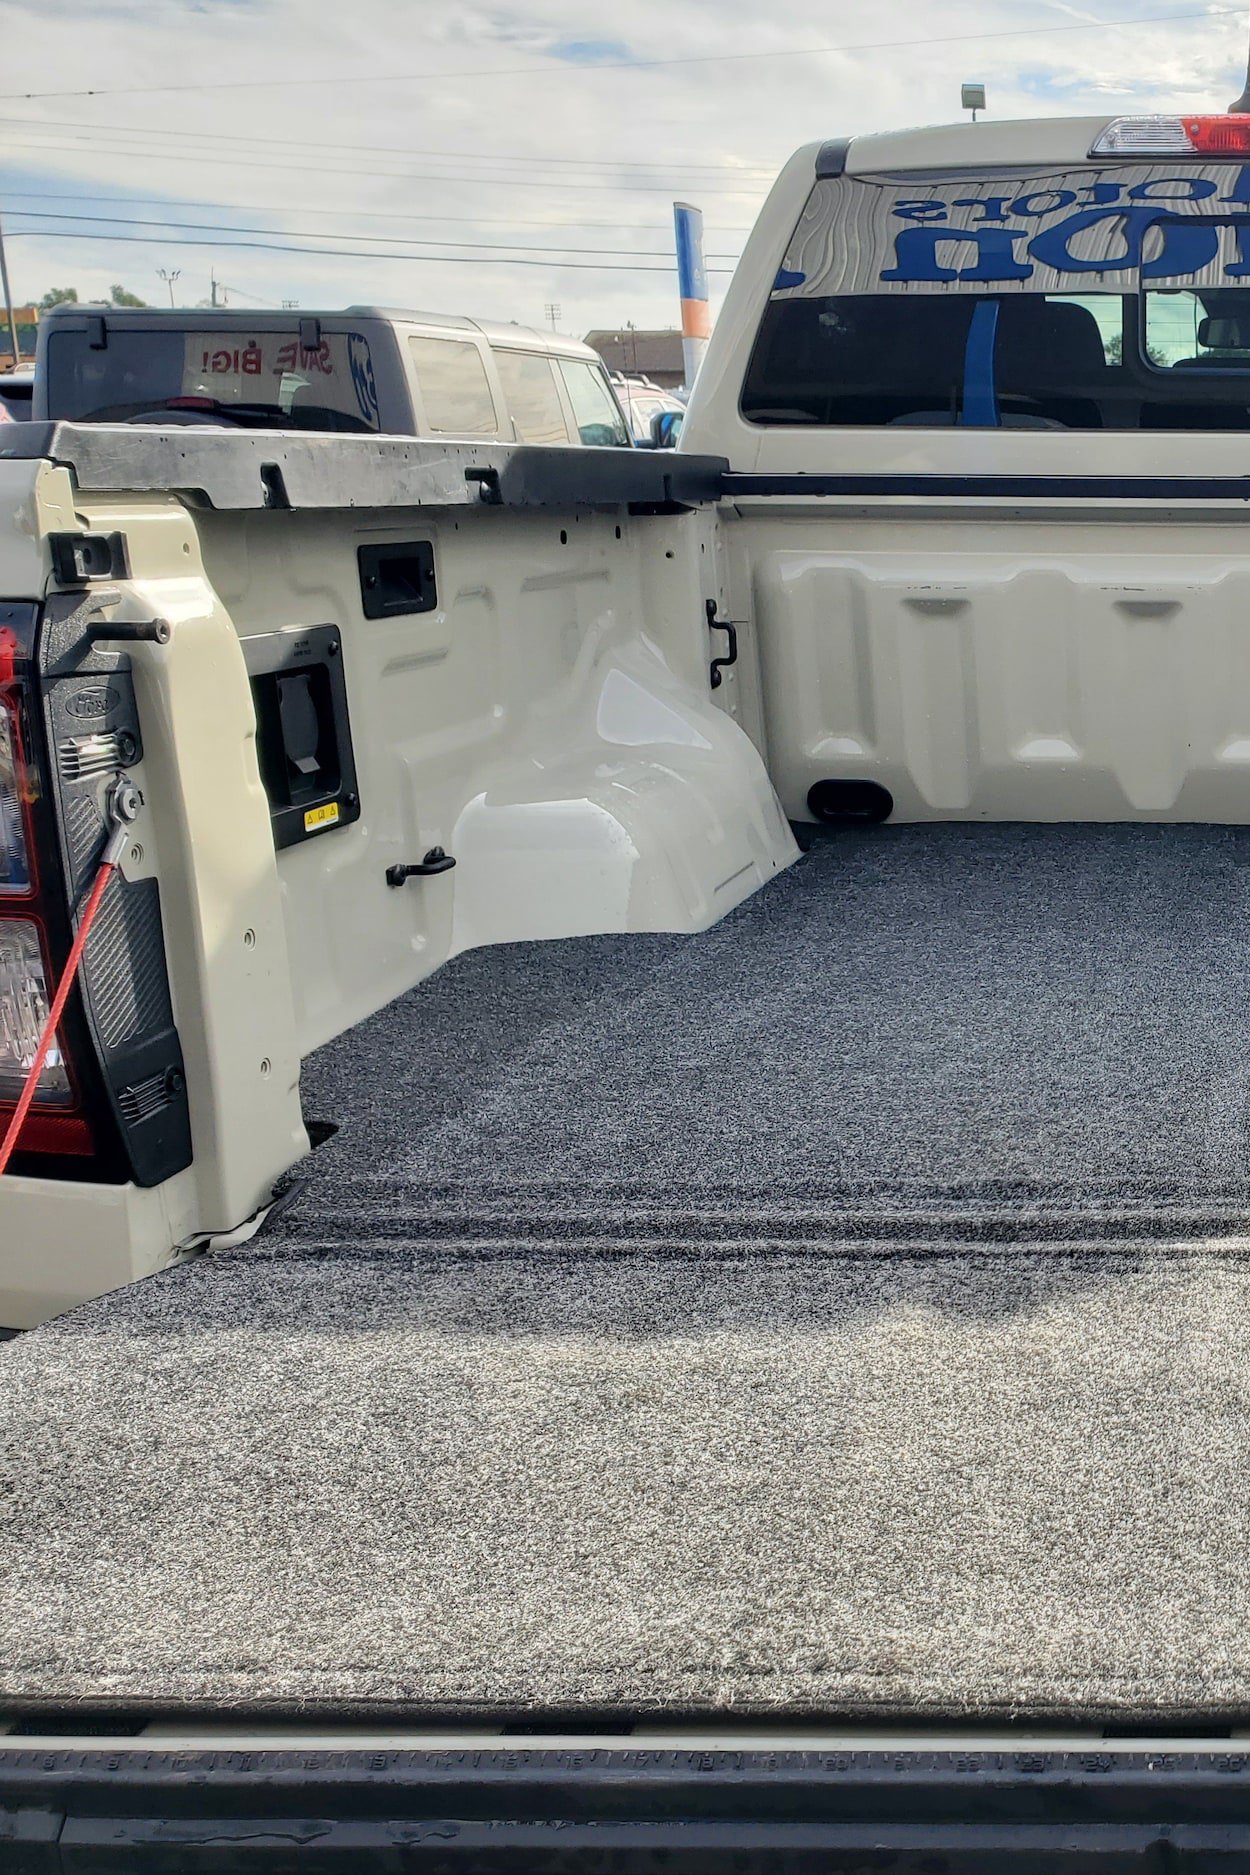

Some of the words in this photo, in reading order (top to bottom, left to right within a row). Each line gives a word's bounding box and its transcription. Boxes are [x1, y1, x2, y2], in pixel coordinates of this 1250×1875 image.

[239, 1756, 252, 1771] 11
[369, 1756, 387, 1771] 13
[697, 1757, 713, 1771] 18
